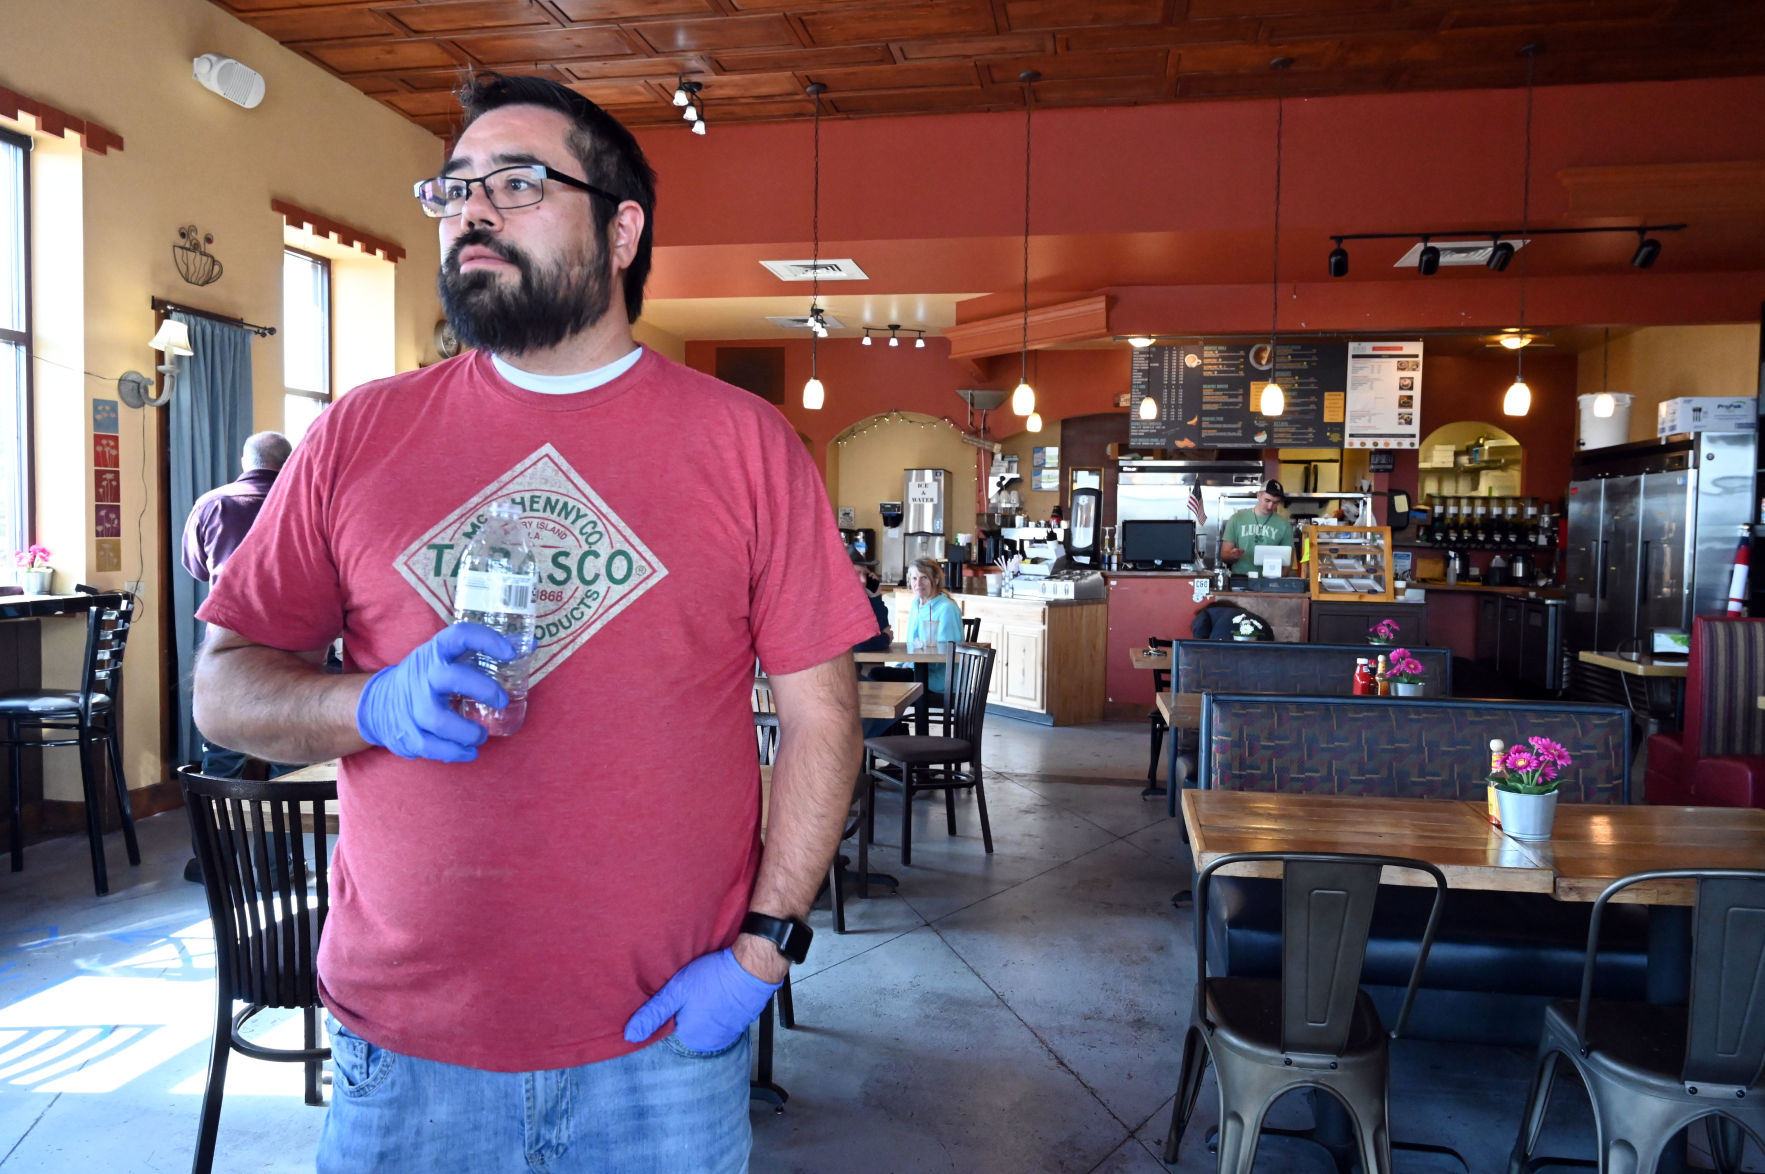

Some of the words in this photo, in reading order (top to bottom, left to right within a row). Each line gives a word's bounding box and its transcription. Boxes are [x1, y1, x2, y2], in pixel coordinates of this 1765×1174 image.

[536, 521, 568, 541] ISLAND
[1241, 524, 1279, 540] LUCKY
[528, 588, 600, 641] ODUCTS
